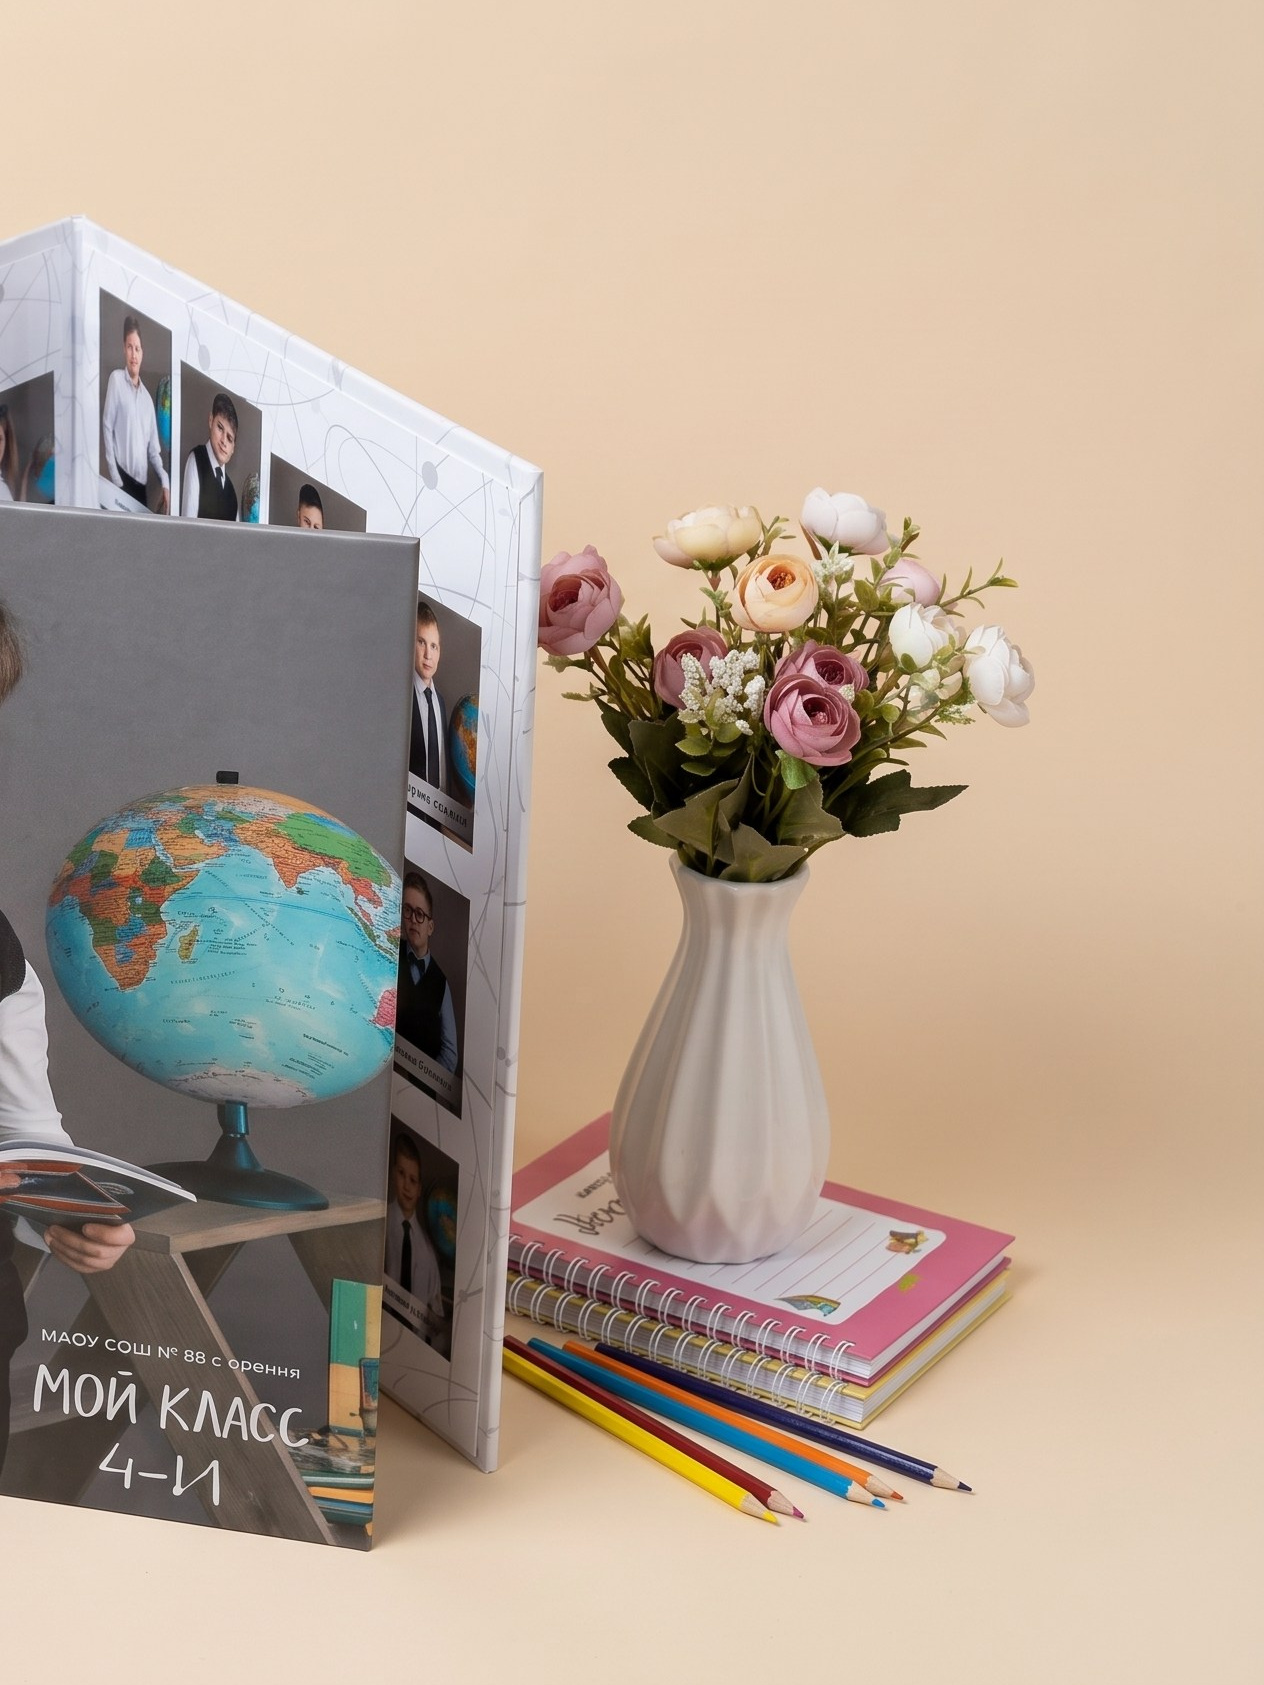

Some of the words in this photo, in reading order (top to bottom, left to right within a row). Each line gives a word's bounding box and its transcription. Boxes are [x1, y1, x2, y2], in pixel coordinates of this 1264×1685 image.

[41, 1328, 99, 1348] МАОУ
[104, 1338, 151, 1357] СОШ
[158, 1345, 178, 1359] №
[183, 1349, 206, 1365] 88
[228, 1358, 300, 1379] орення
[33, 1363, 137, 1424] МОЙ
[159, 1384, 310, 1448] КЛАСС
[98, 1442, 220, 1507] 4-И
